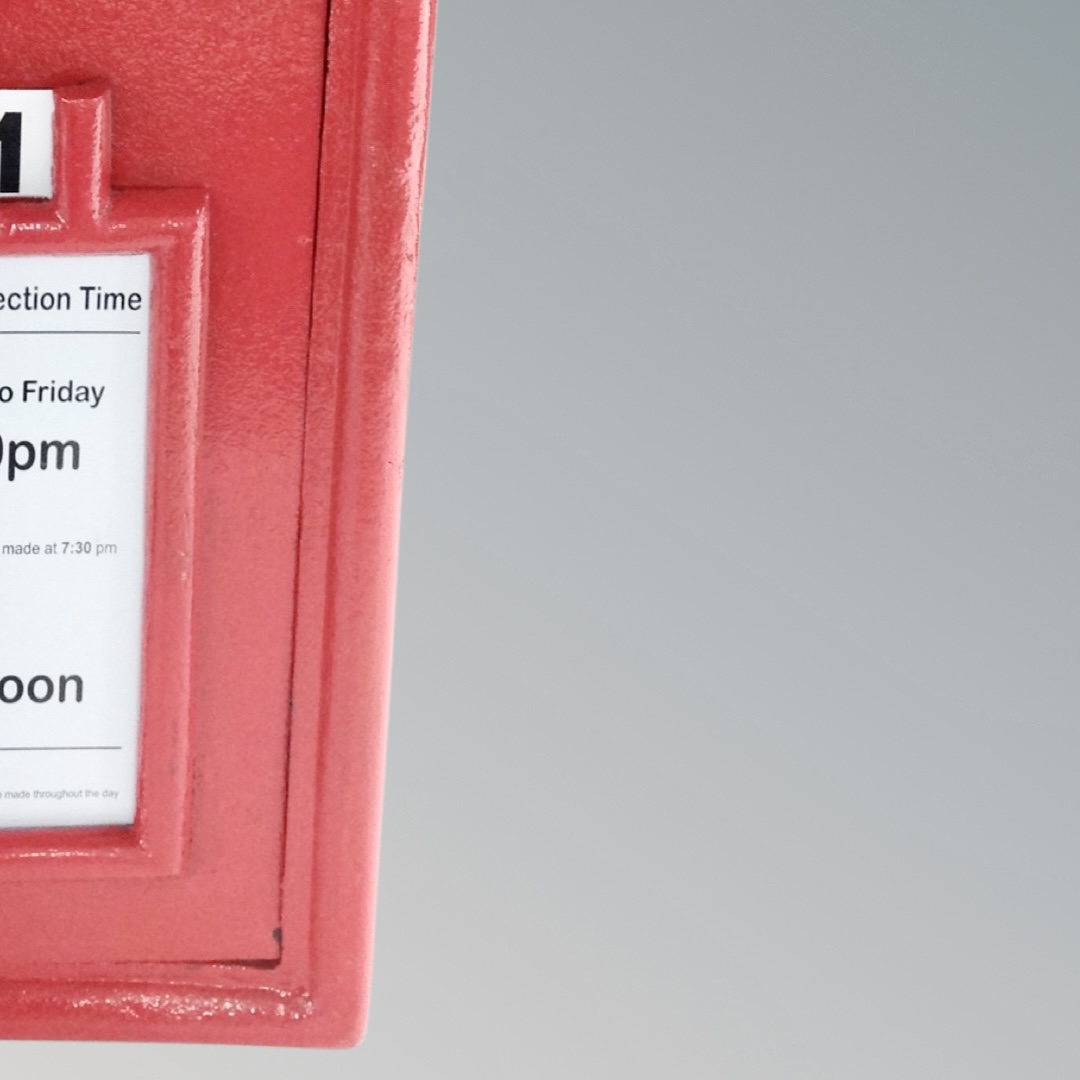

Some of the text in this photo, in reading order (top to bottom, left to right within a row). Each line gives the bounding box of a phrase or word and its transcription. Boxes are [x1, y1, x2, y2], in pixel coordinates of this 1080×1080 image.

[79, 285, 142, 311] Time
[22, 379, 105, 409] Friday
[2, 542, 41, 555] made
[44, 542, 58, 555] at
[61, 541, 92, 555] 7:30
[95, 543, 118, 557] pm
[4, 790, 30, 799] made
[102, 789, 119, 799] day
